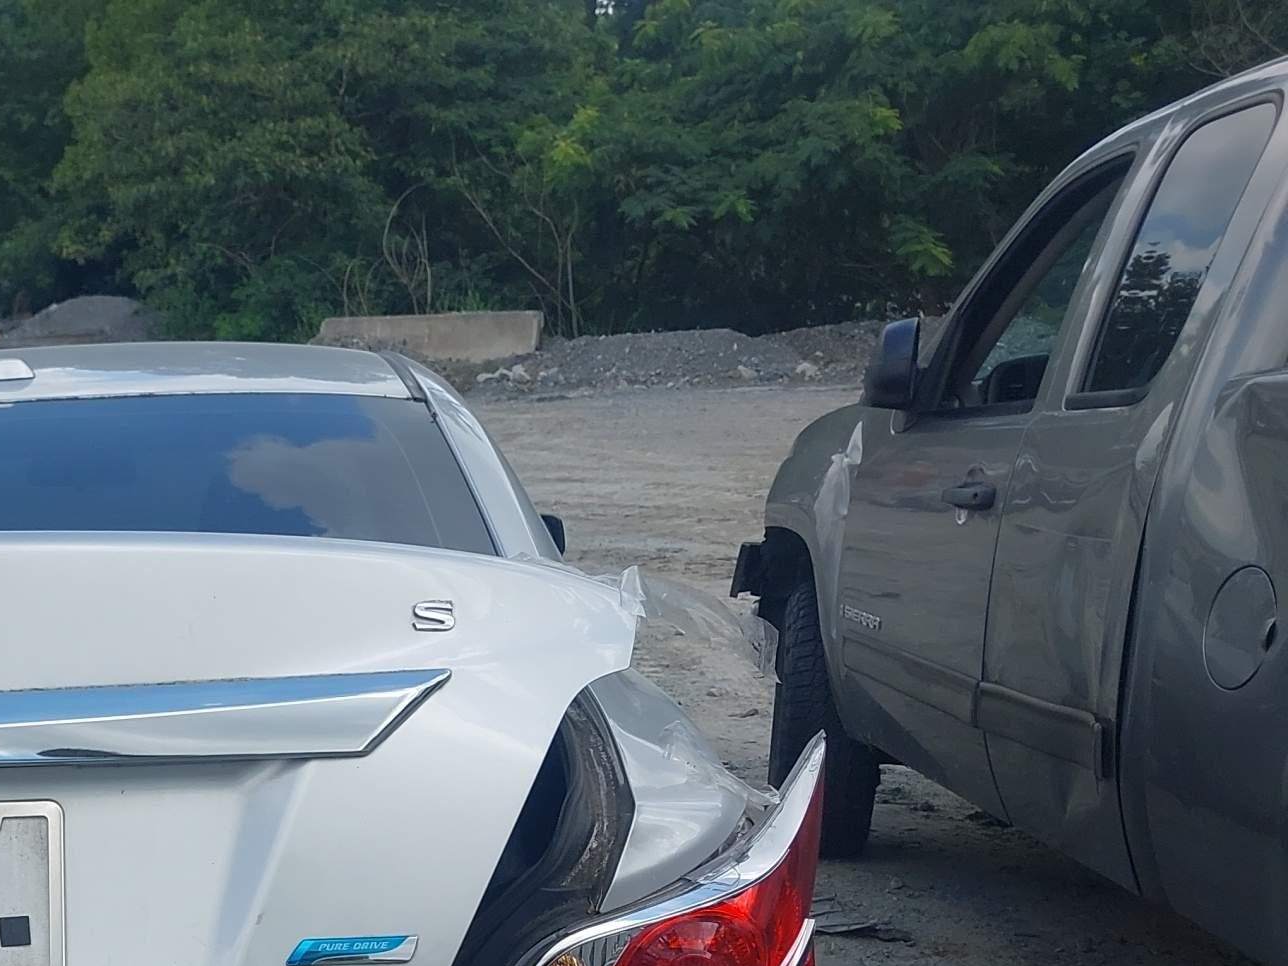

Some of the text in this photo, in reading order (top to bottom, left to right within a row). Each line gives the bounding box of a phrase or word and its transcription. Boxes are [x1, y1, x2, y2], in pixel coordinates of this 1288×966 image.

[412, 600, 455, 632] S
[318, 941, 390, 952] PURE DRIVE
